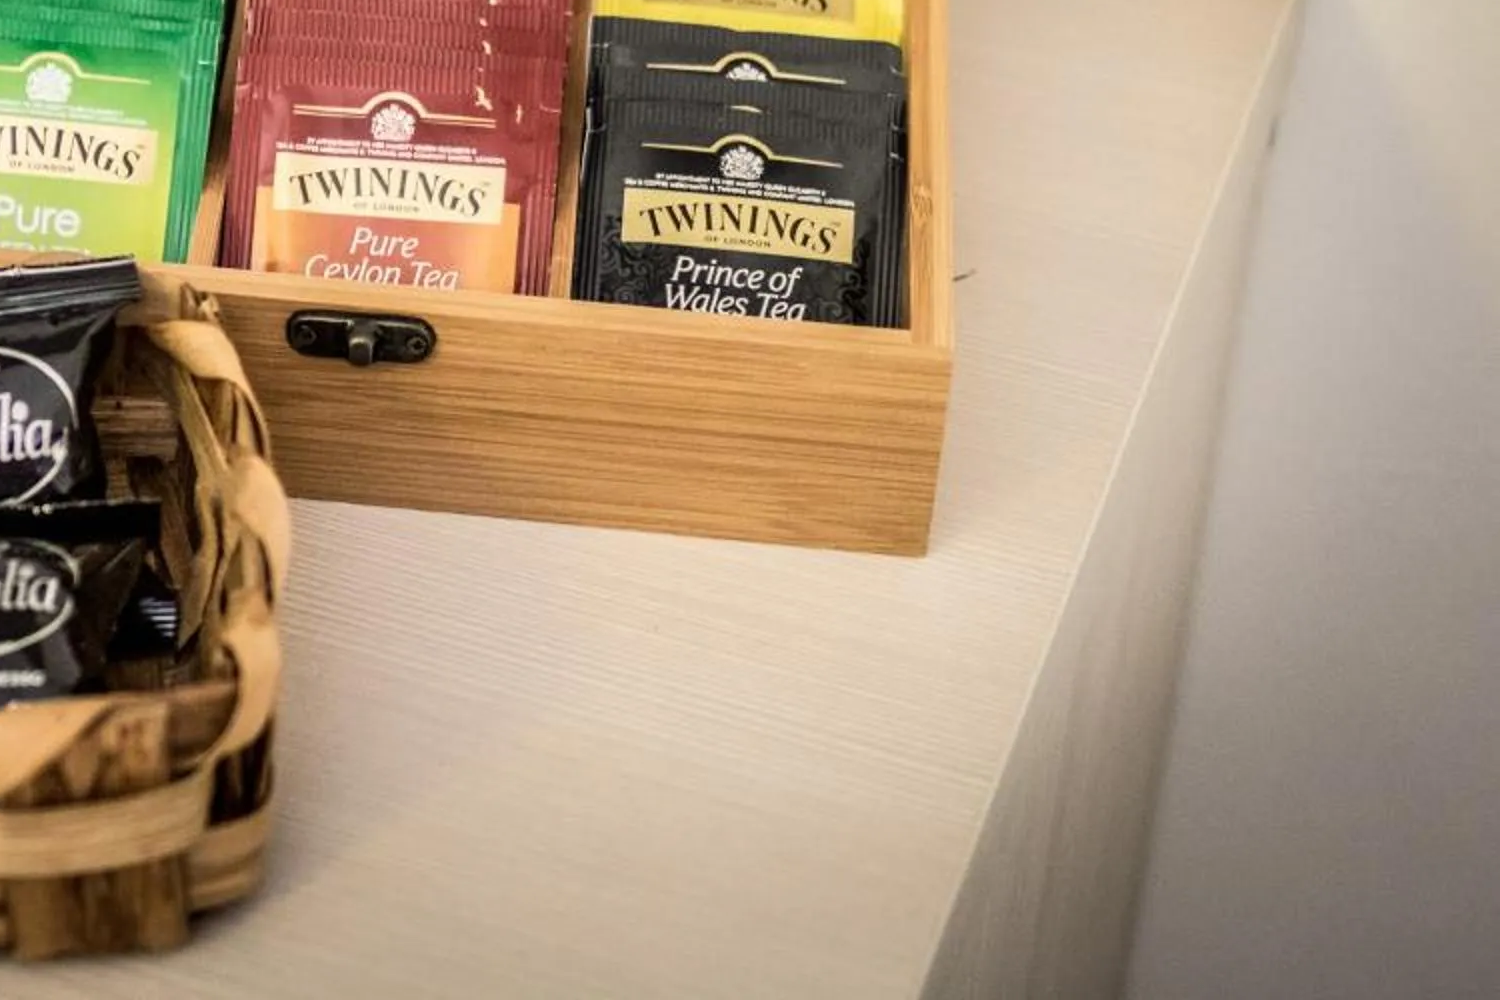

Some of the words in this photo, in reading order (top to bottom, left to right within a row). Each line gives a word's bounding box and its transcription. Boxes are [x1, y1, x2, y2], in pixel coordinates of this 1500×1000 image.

[290, 165, 486, 217] TWININGS
[349, 226, 419, 259] Pure
[639, 202, 837, 255] TWININGS
[411, 260, 460, 292] Tea
[670, 255, 766, 291] Prince
[768, 266, 804, 299] of
[664, 283, 749, 317] Wales
[756, 293, 807, 321] Tea
